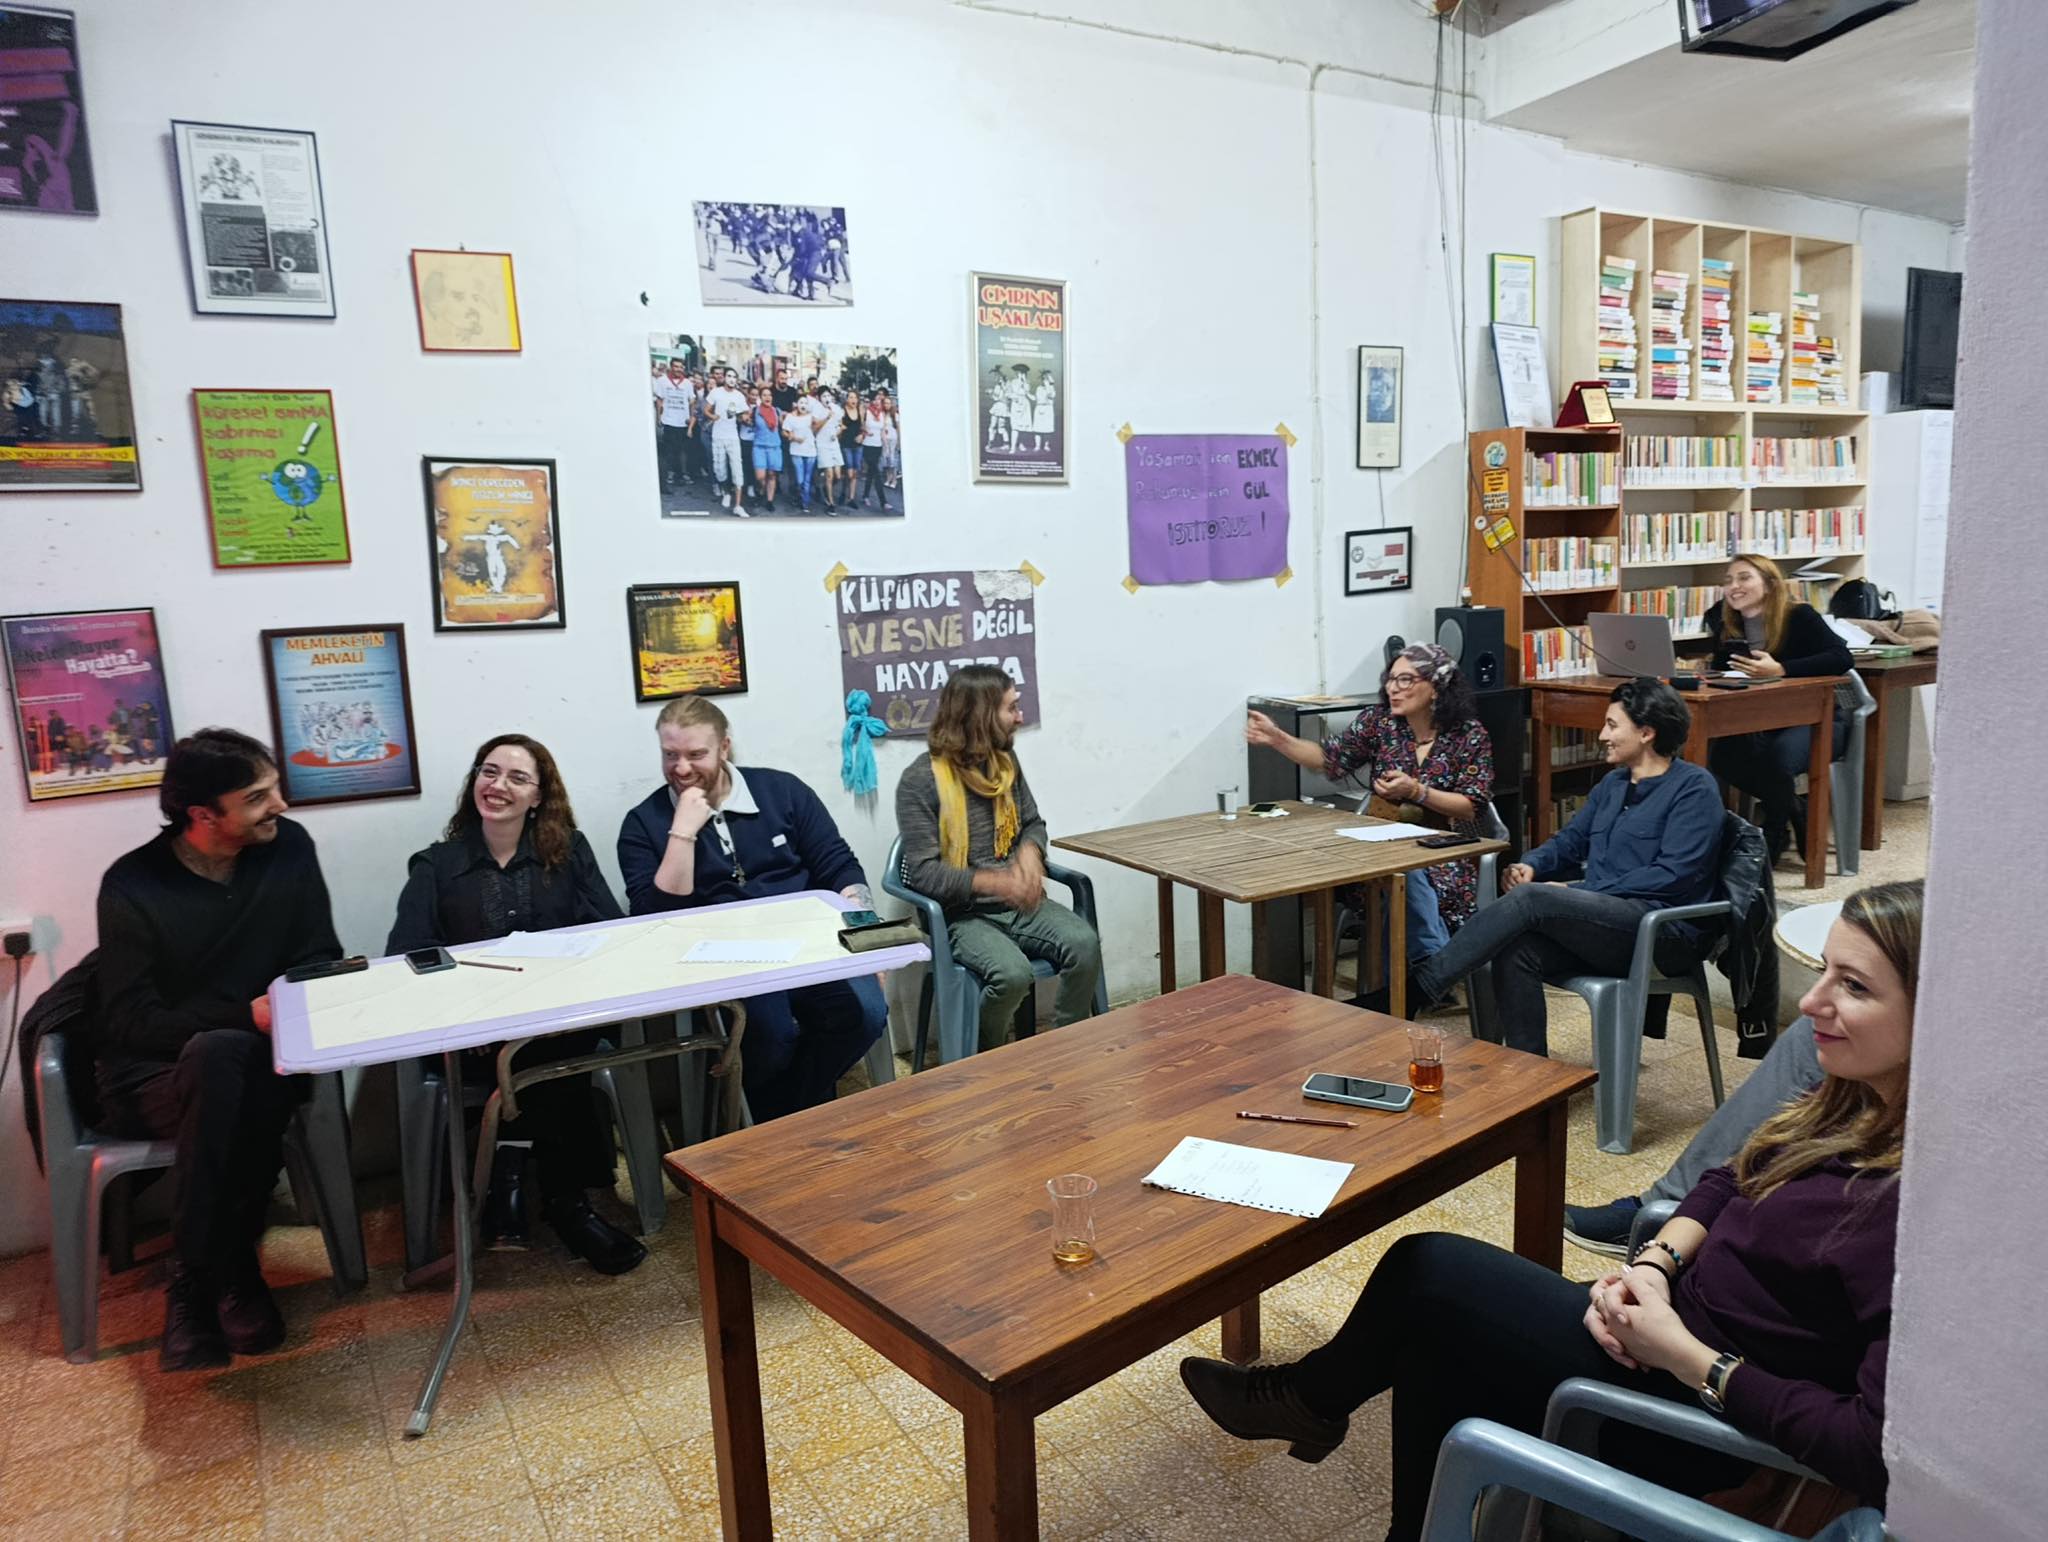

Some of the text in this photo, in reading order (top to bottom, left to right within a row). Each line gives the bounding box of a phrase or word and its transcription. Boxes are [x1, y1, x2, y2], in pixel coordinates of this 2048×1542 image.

[1237, 447, 1279, 469] EKMEK
[1243, 481, 1270, 500] GÜL
[847, 604, 1034, 658] NESNE DEĞİL
[886, 694, 939, 731] ÖZ
